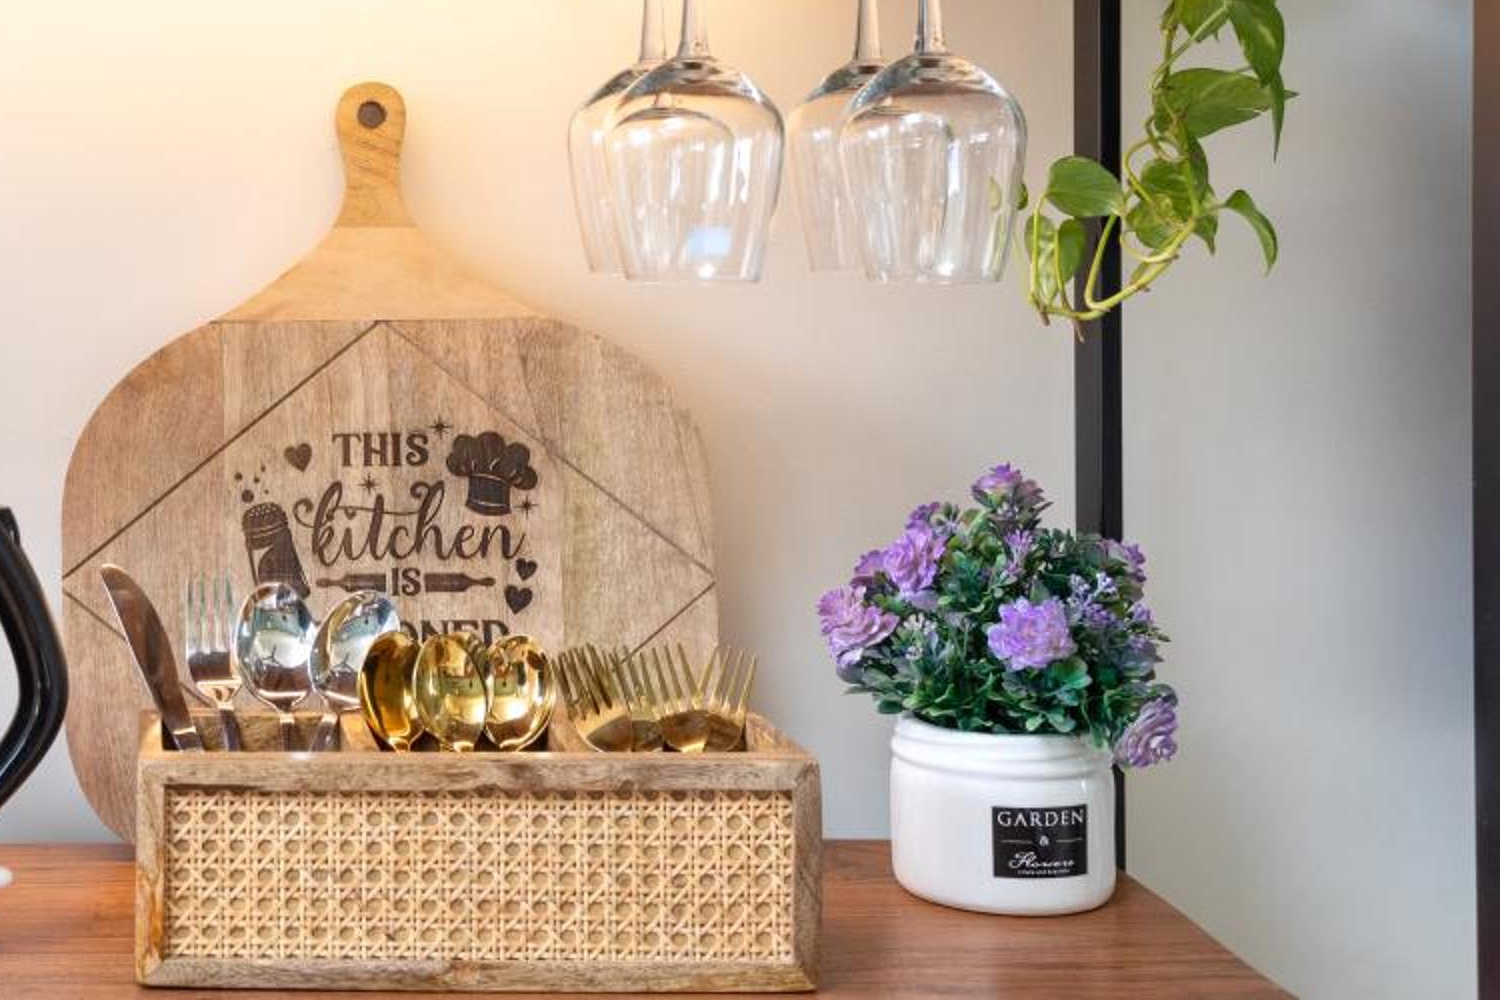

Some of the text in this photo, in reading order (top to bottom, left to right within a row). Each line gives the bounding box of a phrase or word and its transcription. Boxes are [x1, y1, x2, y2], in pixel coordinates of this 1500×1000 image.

[331, 432, 430, 468] THIS
[293, 480, 526, 568] kitchen
[392, 567, 421, 596] IS
[997, 809, 1084, 827] GARDEN
[1039, 835, 1050, 847] &
